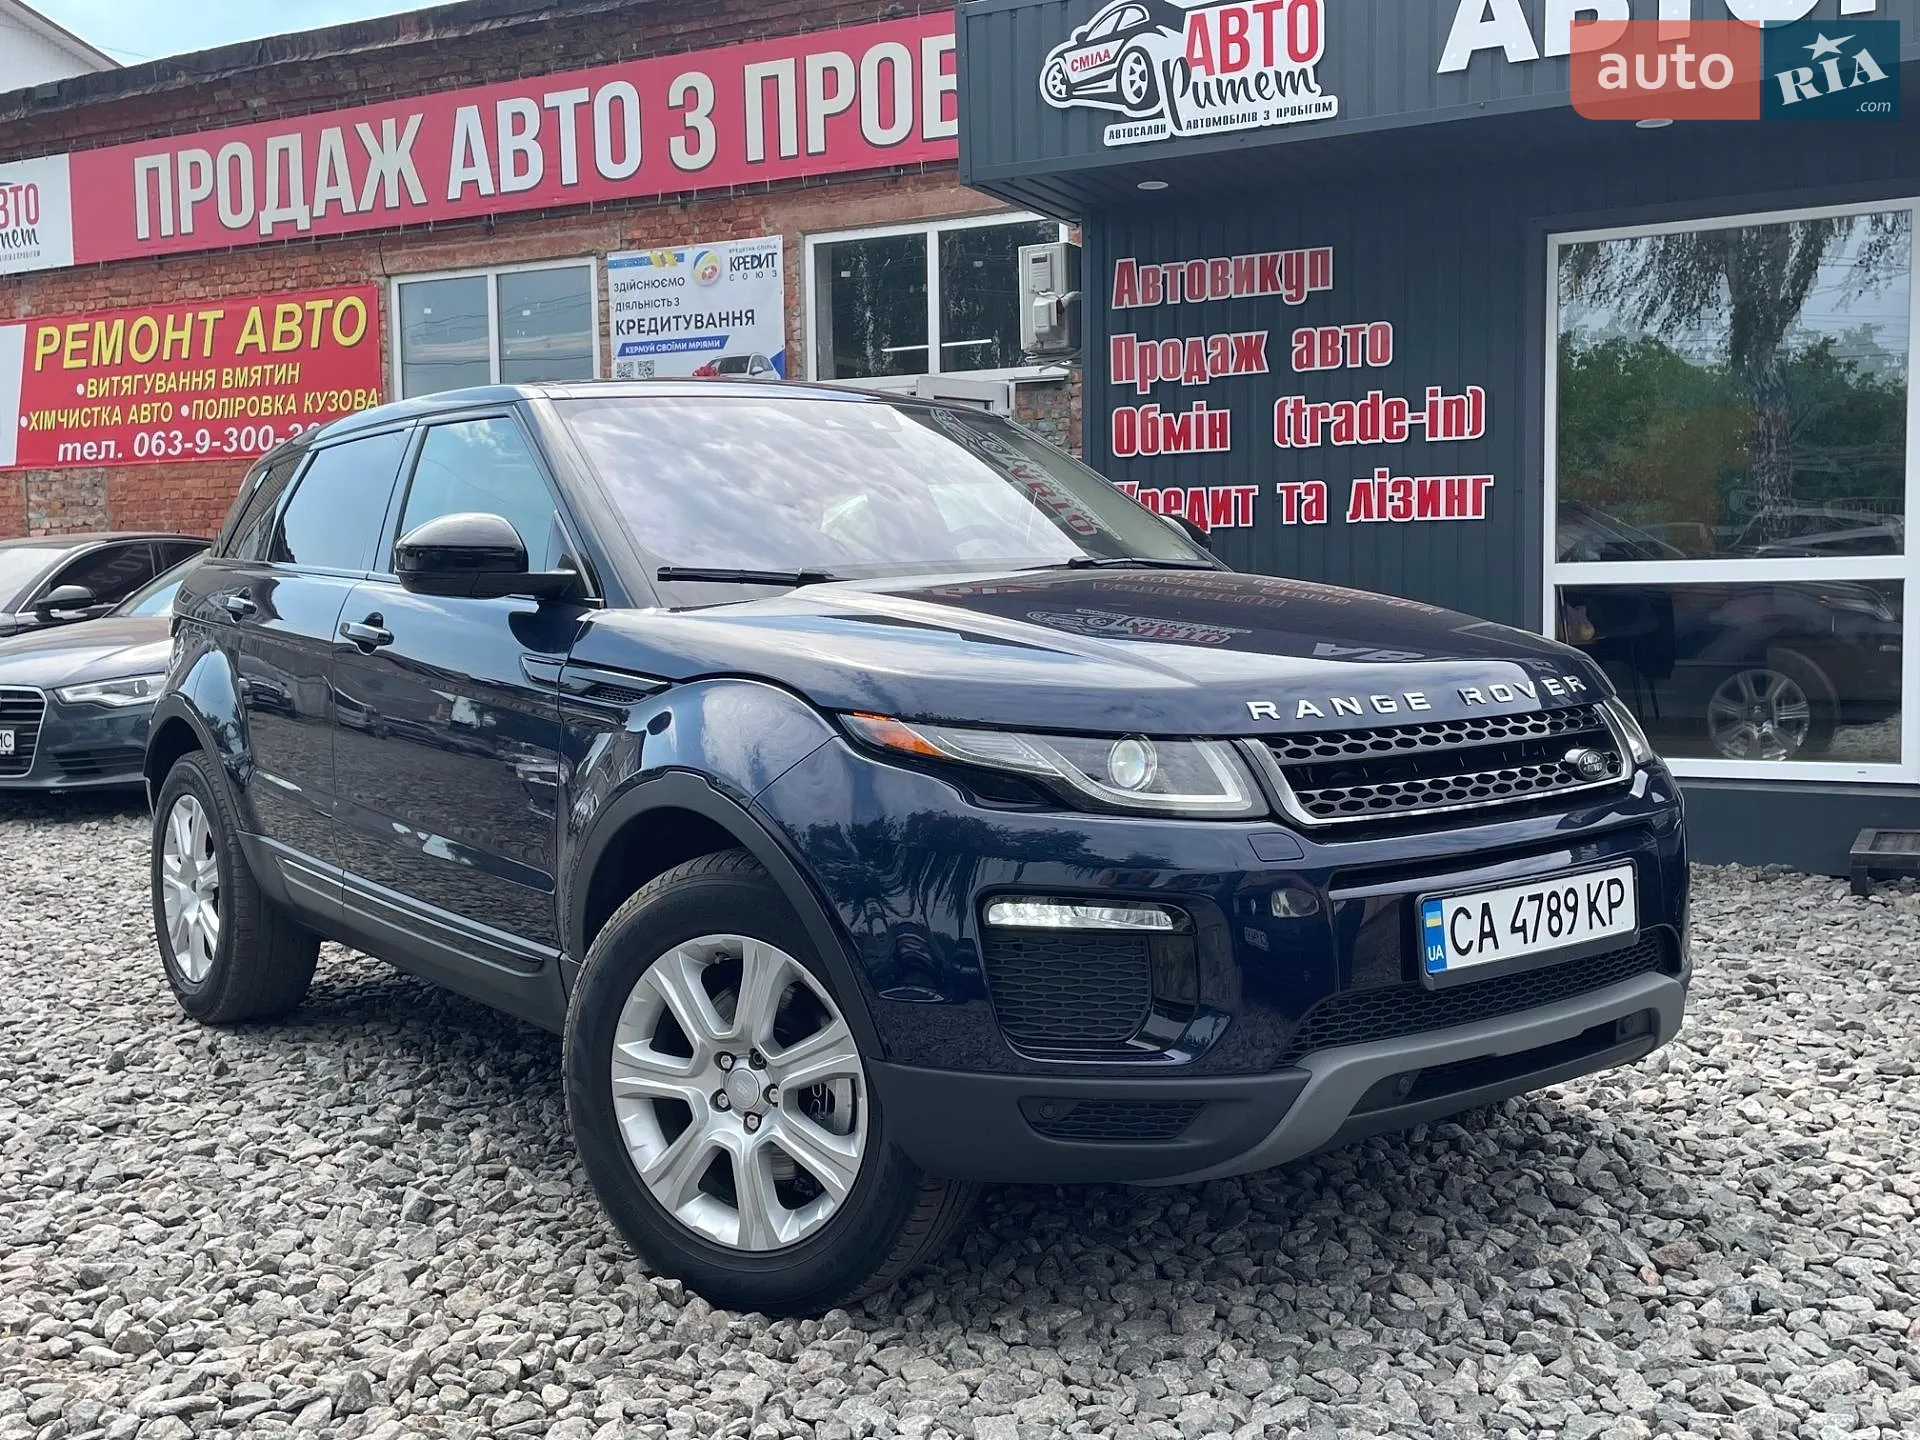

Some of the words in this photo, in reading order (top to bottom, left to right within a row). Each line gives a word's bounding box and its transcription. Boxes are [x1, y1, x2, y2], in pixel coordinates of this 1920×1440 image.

[1070, 48, 1112, 73] СМІЛА
[1184, 0, 1319, 77] АВТО
[1108, 124, 1167, 141] АВТОСАЛОН
[1185, 111, 1258, 131] АВТОМОБІЛІВ
[1276, 101, 1333, 119] ПРОБІГОМ
[133, 113, 428, 241] ПРОДАЖ
[446, 81, 643, 200] АВТО
[613, 276, 685, 292] ЗДІЙСНЮЄМО
[1111, 247, 1333, 310] Автовикуп
[615, 299, 673, 312] ДІЯЛЬНІСТЬ
[616, 309, 755, 336] КРЕДИТУВАННЯ
[33, 309, 225, 373] РЕМОНТ
[235, 295, 368, 355] АВТО
[625, 345, 655, 354] КЕРМУЙ
[656, 342, 688, 352] СВОЇМИ
[688, 340, 721, 349] МРІЯМИ
[86, 368, 216, 399] ВИТЯГУВАННЯ
[221, 362, 301, 389] ВМЯТИН
[1110, 330, 1269, 395] Продаж
[1292, 321, 1393, 373] авто
[28, 404, 122, 432] ХІМЧИСТКА
[127, 401, 173, 426] АВТО
[191, 393, 297, 421] ПОЛІРОВКА
[303, 387, 379, 414] КУЗОВА
[1112, 401, 1231, 457] Обмін
[1273, 386, 1486, 448] (trade-in)
[58, 440, 123, 462] тел.
[1276, 480, 1327, 525] та
[1346, 467, 1494, 524] лізинг
[1246, 691, 1432, 721] RANGE
[1457, 675, 1587, 707] ROVER
[1450, 901, 1499, 956] CA
[1510, 886, 1579, 945] 4789
[1586, 877, 1625, 930] KP
[1428, 945, 1444, 962] UA
